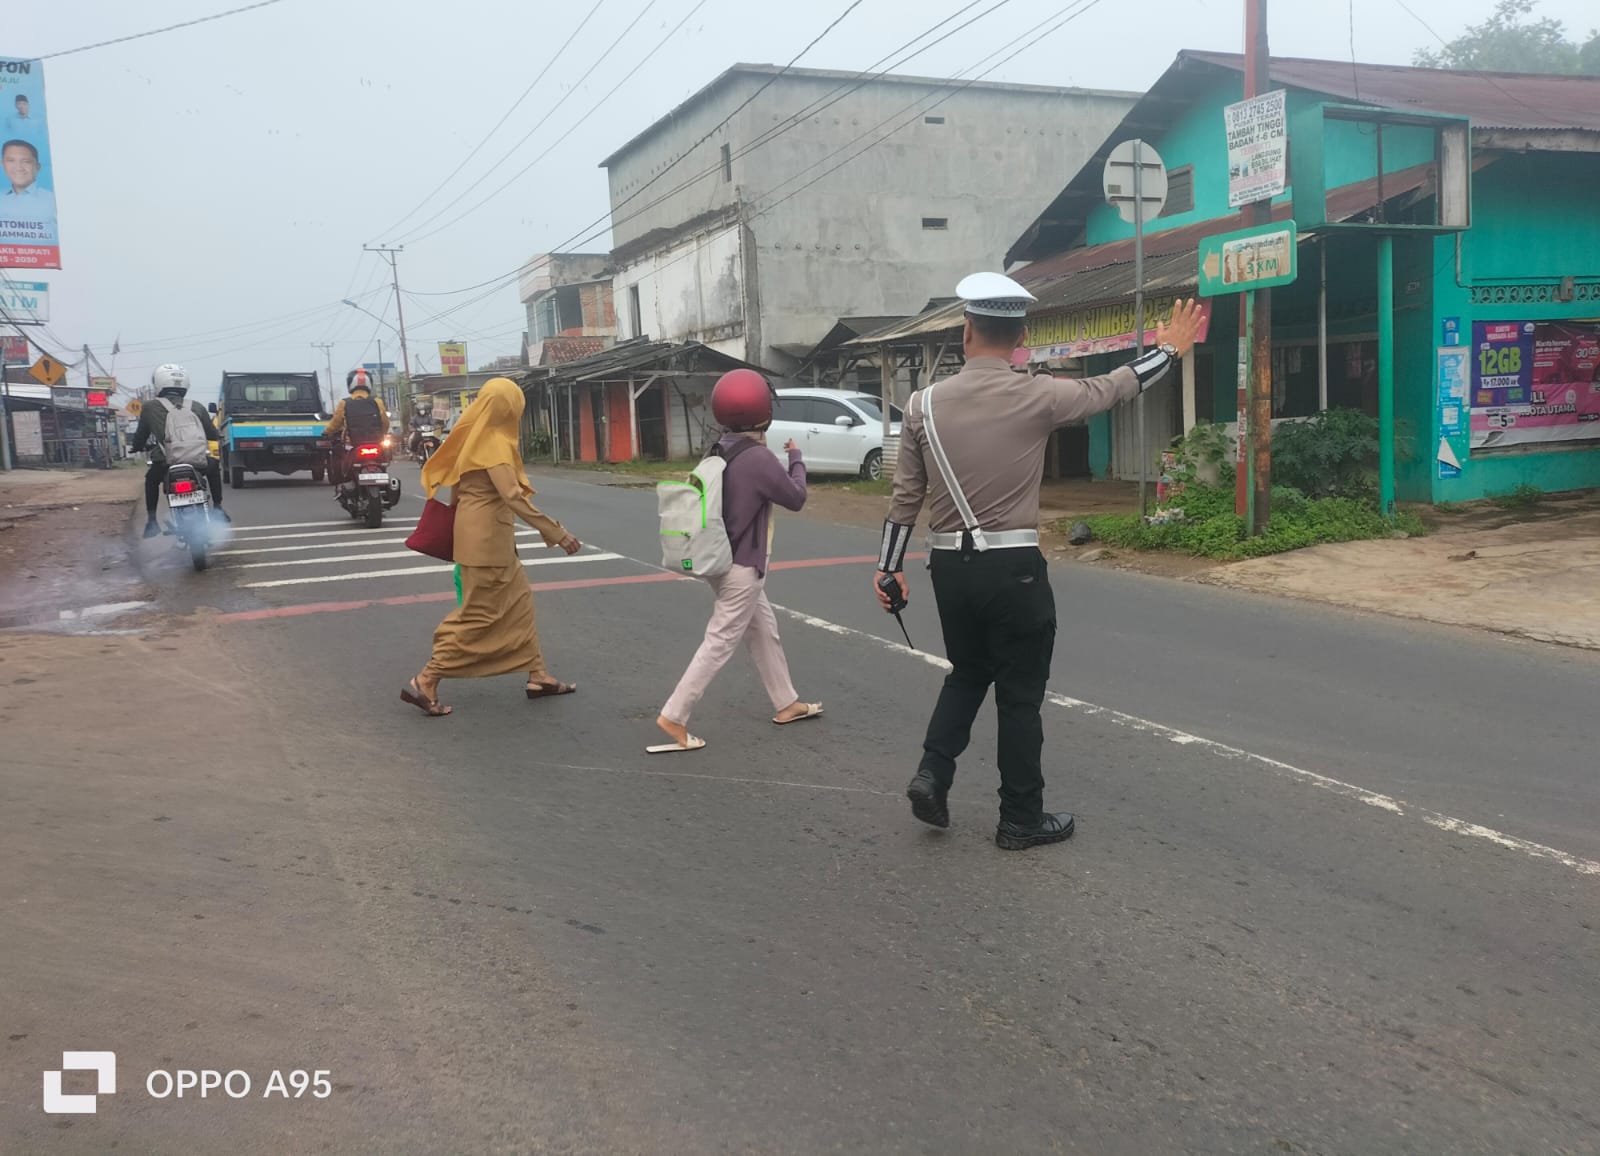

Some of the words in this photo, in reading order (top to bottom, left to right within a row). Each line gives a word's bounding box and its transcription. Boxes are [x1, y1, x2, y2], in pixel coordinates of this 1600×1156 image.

[1227, 125, 1254, 141] TAMBAH
[1257, 116, 1283, 133] TINGGI
[1228, 136, 1253, 150] BADAN
[1270, 127, 1283, 139] CM
[0, 220, 44, 230] TONIUS
[0, 231, 37, 239] AMMAD
[1023, 312, 1079, 347] SEMBAKO
[1479, 347, 1521, 376] 12GB
